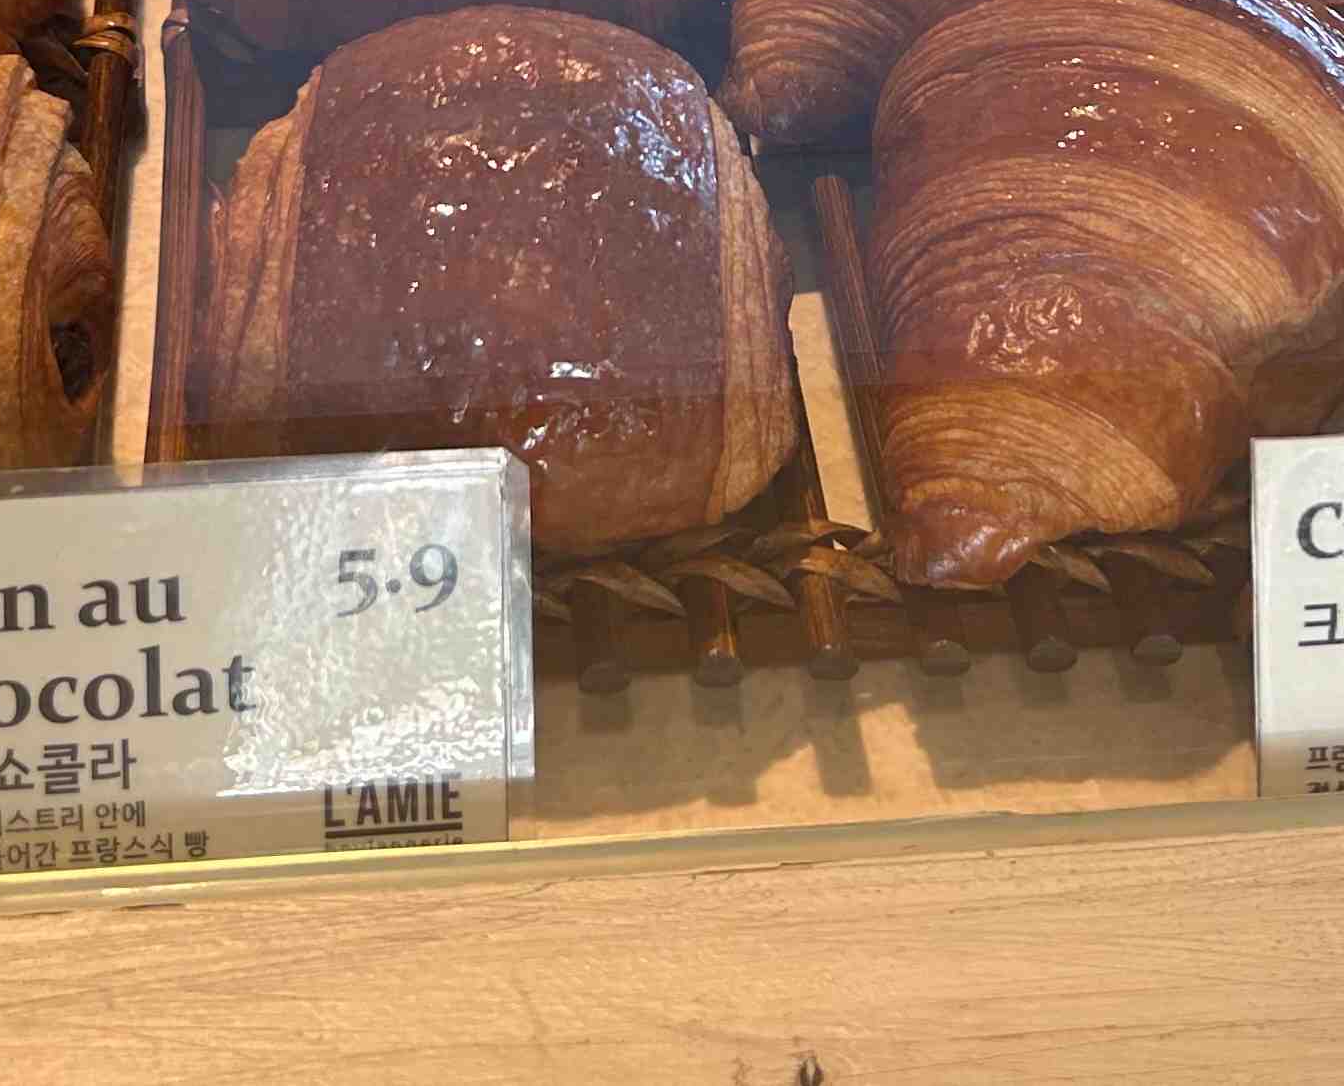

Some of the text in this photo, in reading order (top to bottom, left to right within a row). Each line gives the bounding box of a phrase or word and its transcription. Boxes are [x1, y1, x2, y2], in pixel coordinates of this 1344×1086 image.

[78, 572, 186, 630] au
[95, 800, 147, 830] 안에
[323, 772, 463, 828] L'AMIE
[68, 832, 175, 864] 프랑스식
[183, 830, 210, 858] 빵
